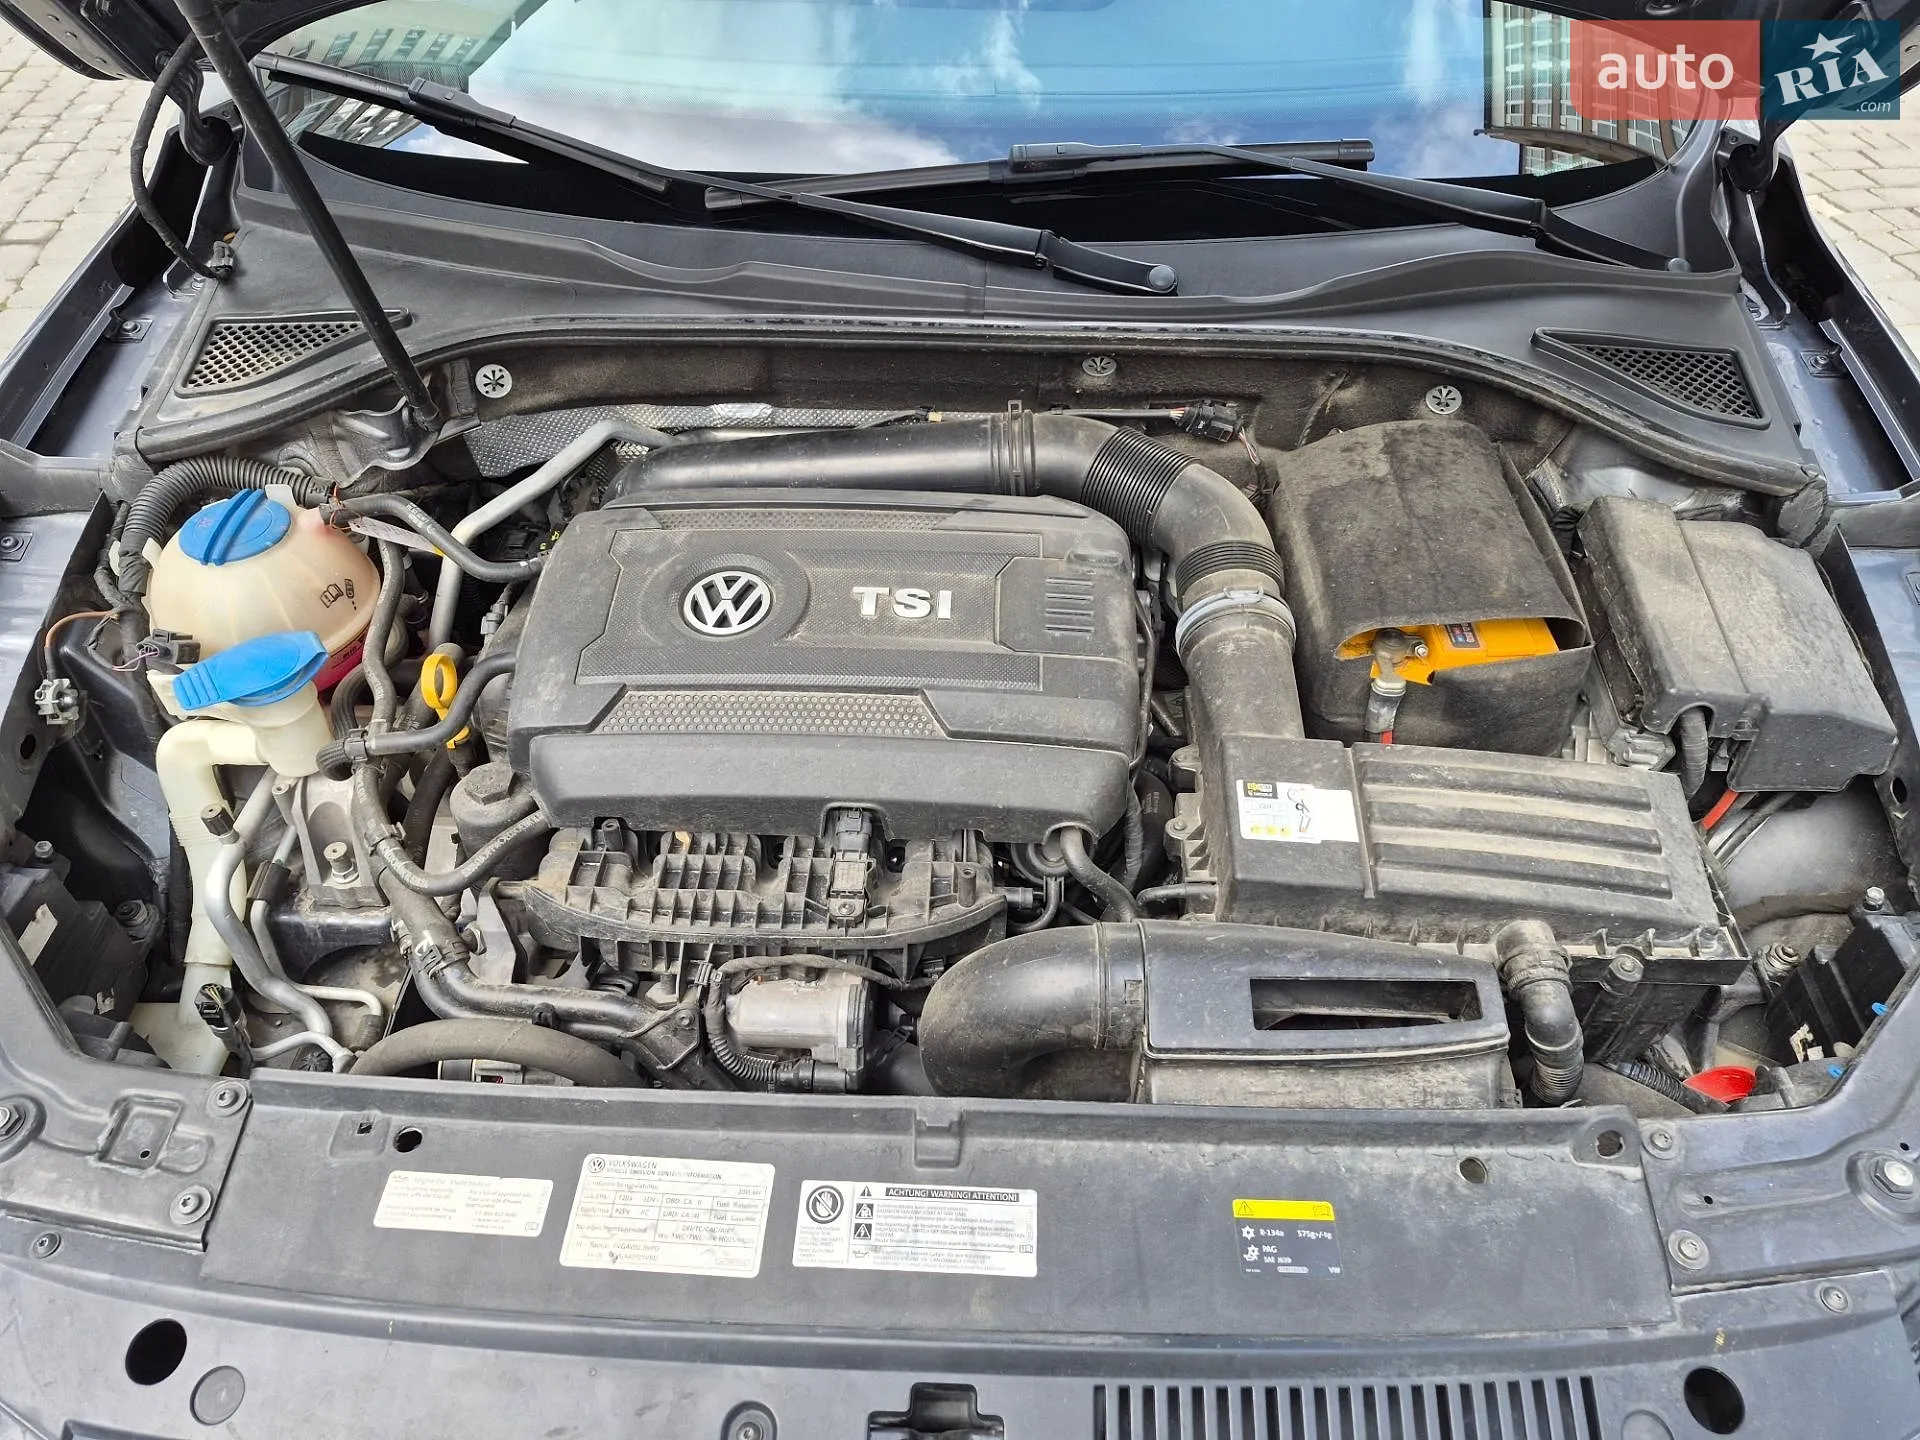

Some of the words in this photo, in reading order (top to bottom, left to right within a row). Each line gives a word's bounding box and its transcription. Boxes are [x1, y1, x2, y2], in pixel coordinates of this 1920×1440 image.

[852, 586, 953, 621] TSI
[608, 1159, 658, 1169] VOLKSWAGEN
[683, 1171, 722, 1179] INFORMATION
[888, 1188, 929, 1197] ACHTUNG!
[930, 1189, 971, 1199] WARNING!
[972, 1191, 1017, 1202] ATTENTION!
[1262, 1245, 1278, 1254] PAG
